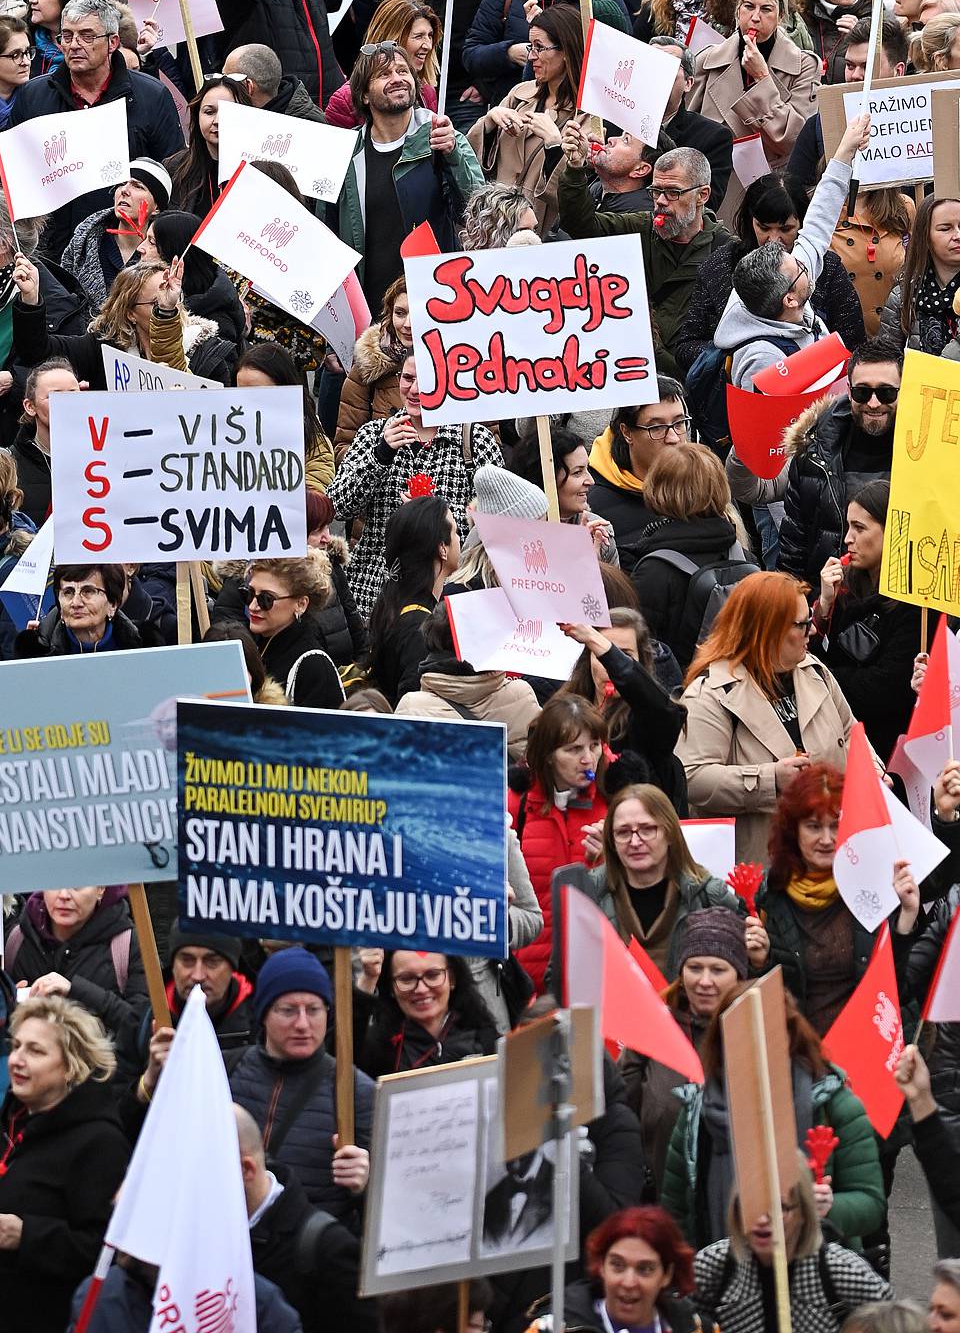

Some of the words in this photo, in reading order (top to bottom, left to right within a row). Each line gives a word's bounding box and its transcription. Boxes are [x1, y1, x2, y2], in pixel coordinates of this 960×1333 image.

[603, 86, 635, 110] PREPOROD
[859, 95, 927, 114] RAŽIMO
[869, 118, 932, 138] OEFICIJE
[41, 161, 84, 187] PREPOROD
[861, 145, 902, 162] MALO
[237, 231, 289, 274] PREPOROD
[425, 253, 633, 334] Svugdje
[114, 359, 131, 390] AP
[419, 328, 607, 410] Jednaki
[88, 416, 109, 451] V
[178, 406, 263, 446] VIŠI
[84, 461, 111, 498] S
[159, 448, 304, 492] STANDARD
[82, 507, 112, 552] S
[157, 505, 291, 553] SVIMA
[511, 577, 566, 593] PREPOROD
[8, 728, 22, 753] LI
[23, 727, 44, 752] SE
[46, 723, 87, 750] GDJE
[88, 720, 111, 746] SU
[80, 748, 171, 797] MLADI
[184, 752, 246, 787] ŽIVIMO
[248, 762, 263, 788] LI
[266, 764, 290, 790] MI
[292, 766, 305, 792] U
[306, 766, 368, 796] NEKOM
[184, 785, 297, 819] PARALELNOM
[299, 793, 388, 825] SVEMIRU?
[185, 818, 260, 867] STAN
[266, 824, 276, 868] I
[282, 824, 388, 877] HRANA
[393, 833, 403, 879] I
[186, 874, 280, 925] NAMA
[284, 874, 417, 937] KOŠTAJU
[421, 886, 498, 944] VIŠE!
